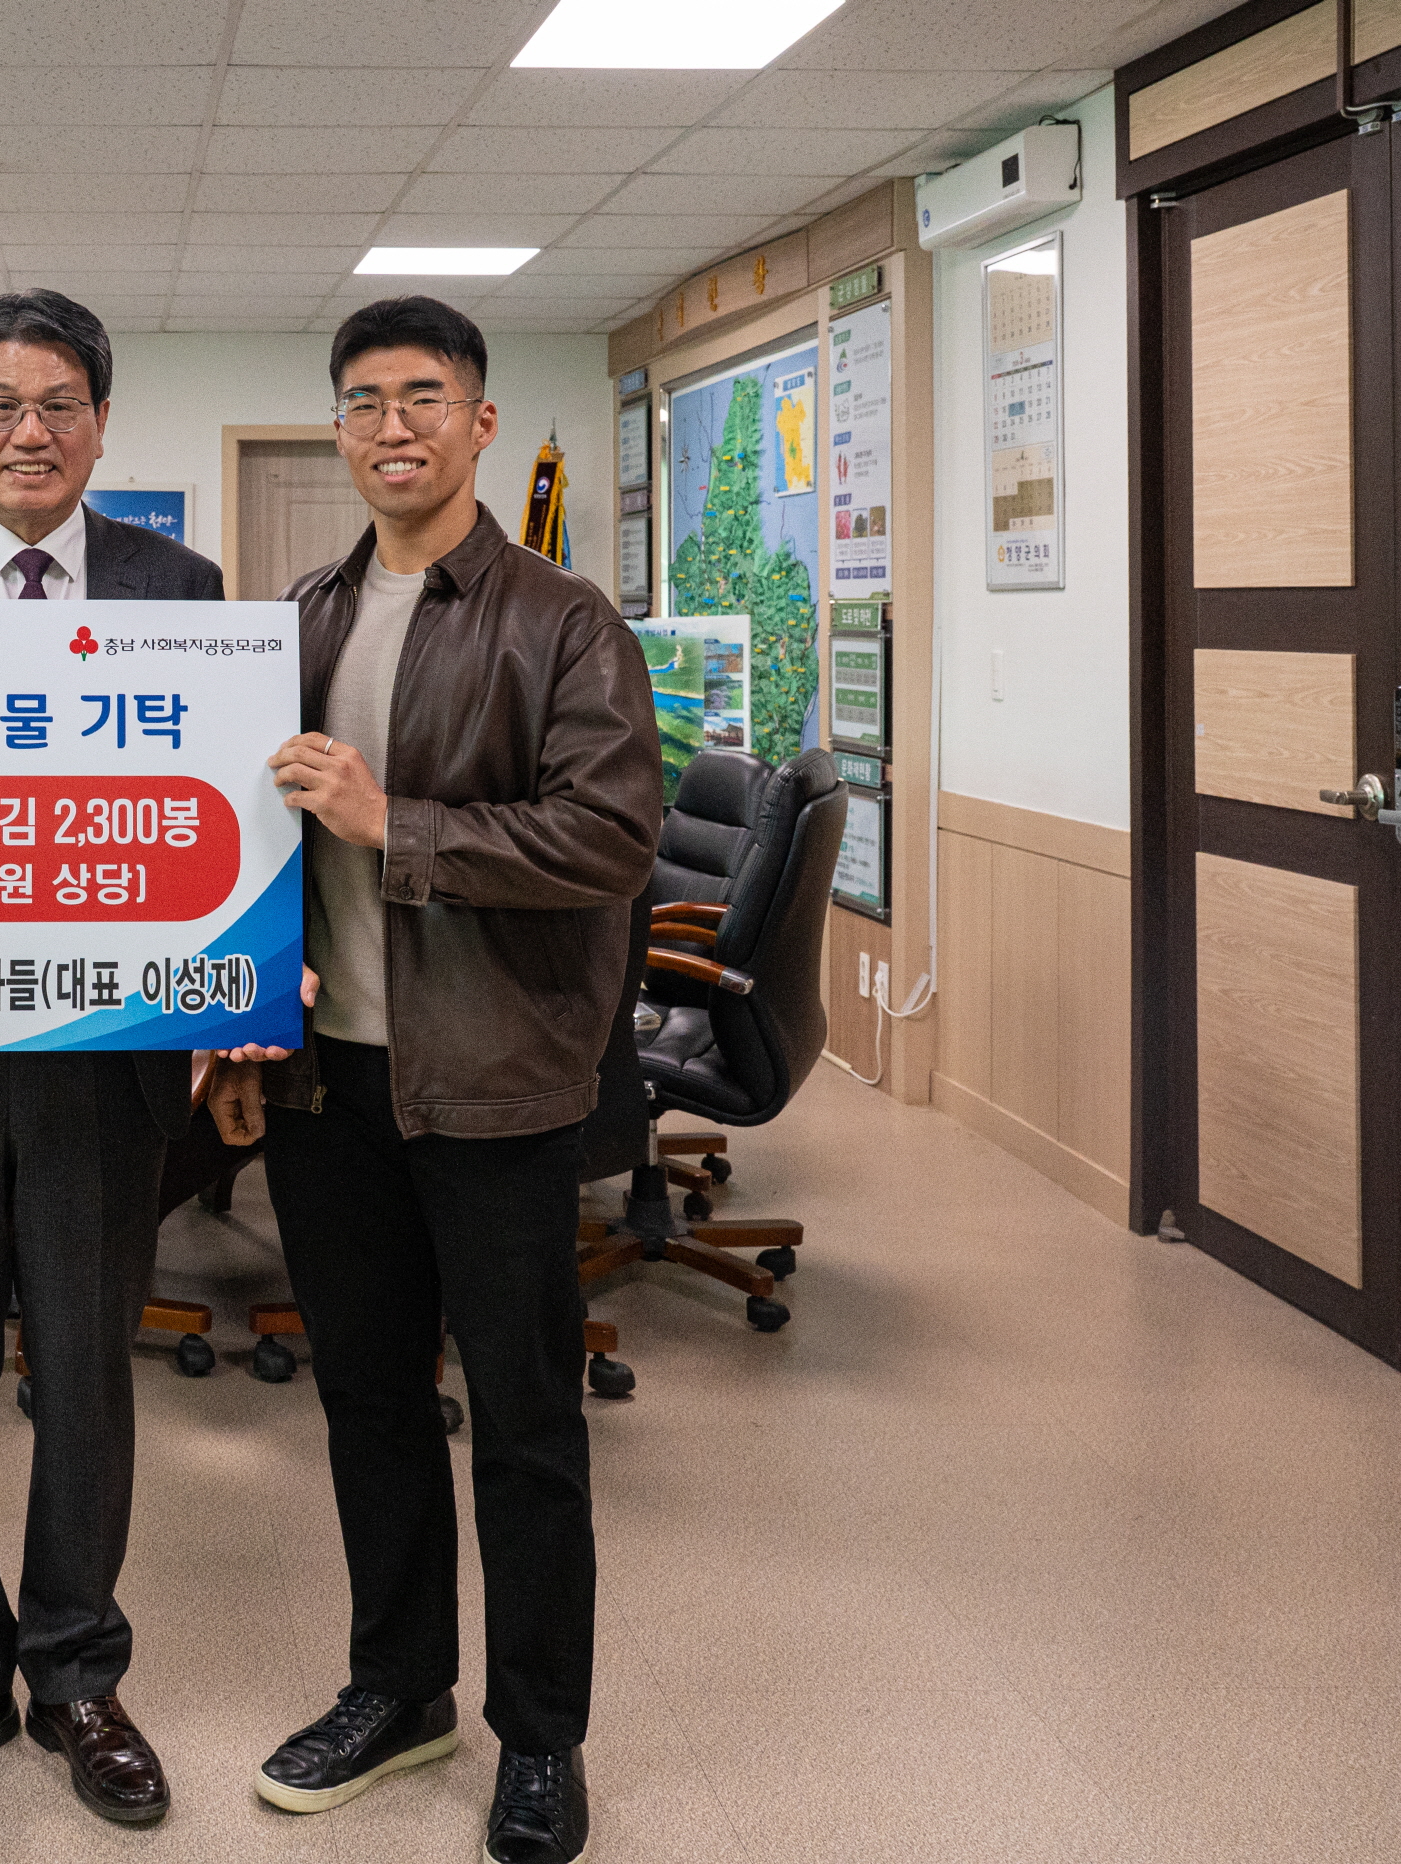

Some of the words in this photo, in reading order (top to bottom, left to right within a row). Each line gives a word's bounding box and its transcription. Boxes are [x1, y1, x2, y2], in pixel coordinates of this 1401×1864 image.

[103, 638, 136, 656] 충남
[140, 638, 282, 656] 사회복지공동모금회
[81, 693, 189, 751] 기탁
[54, 797, 200, 848] 2,300봉
[142, 957, 256, 1013] 이성재)
